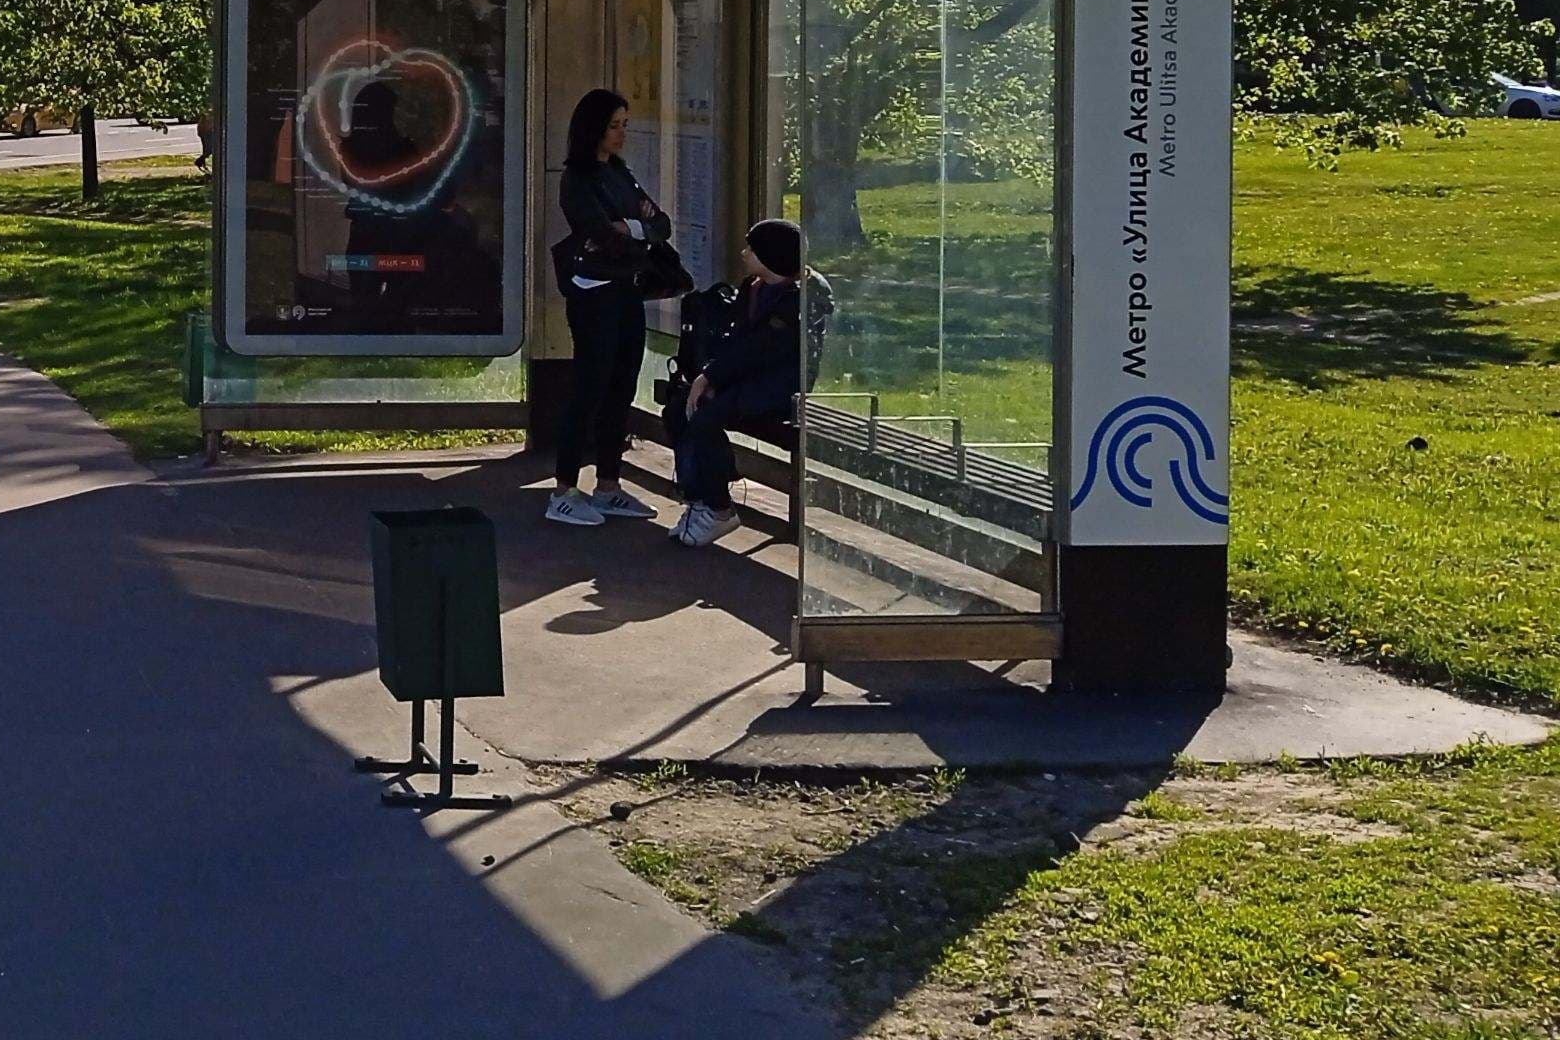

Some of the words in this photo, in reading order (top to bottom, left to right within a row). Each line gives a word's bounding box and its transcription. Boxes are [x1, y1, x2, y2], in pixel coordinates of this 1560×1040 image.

[1159, 50, 1177, 107] Ulitsa
[1159, 113, 1175, 178] Metro
[1122, 151, 1151, 264] «Улица
[1122, 272, 1152, 379] Метро
